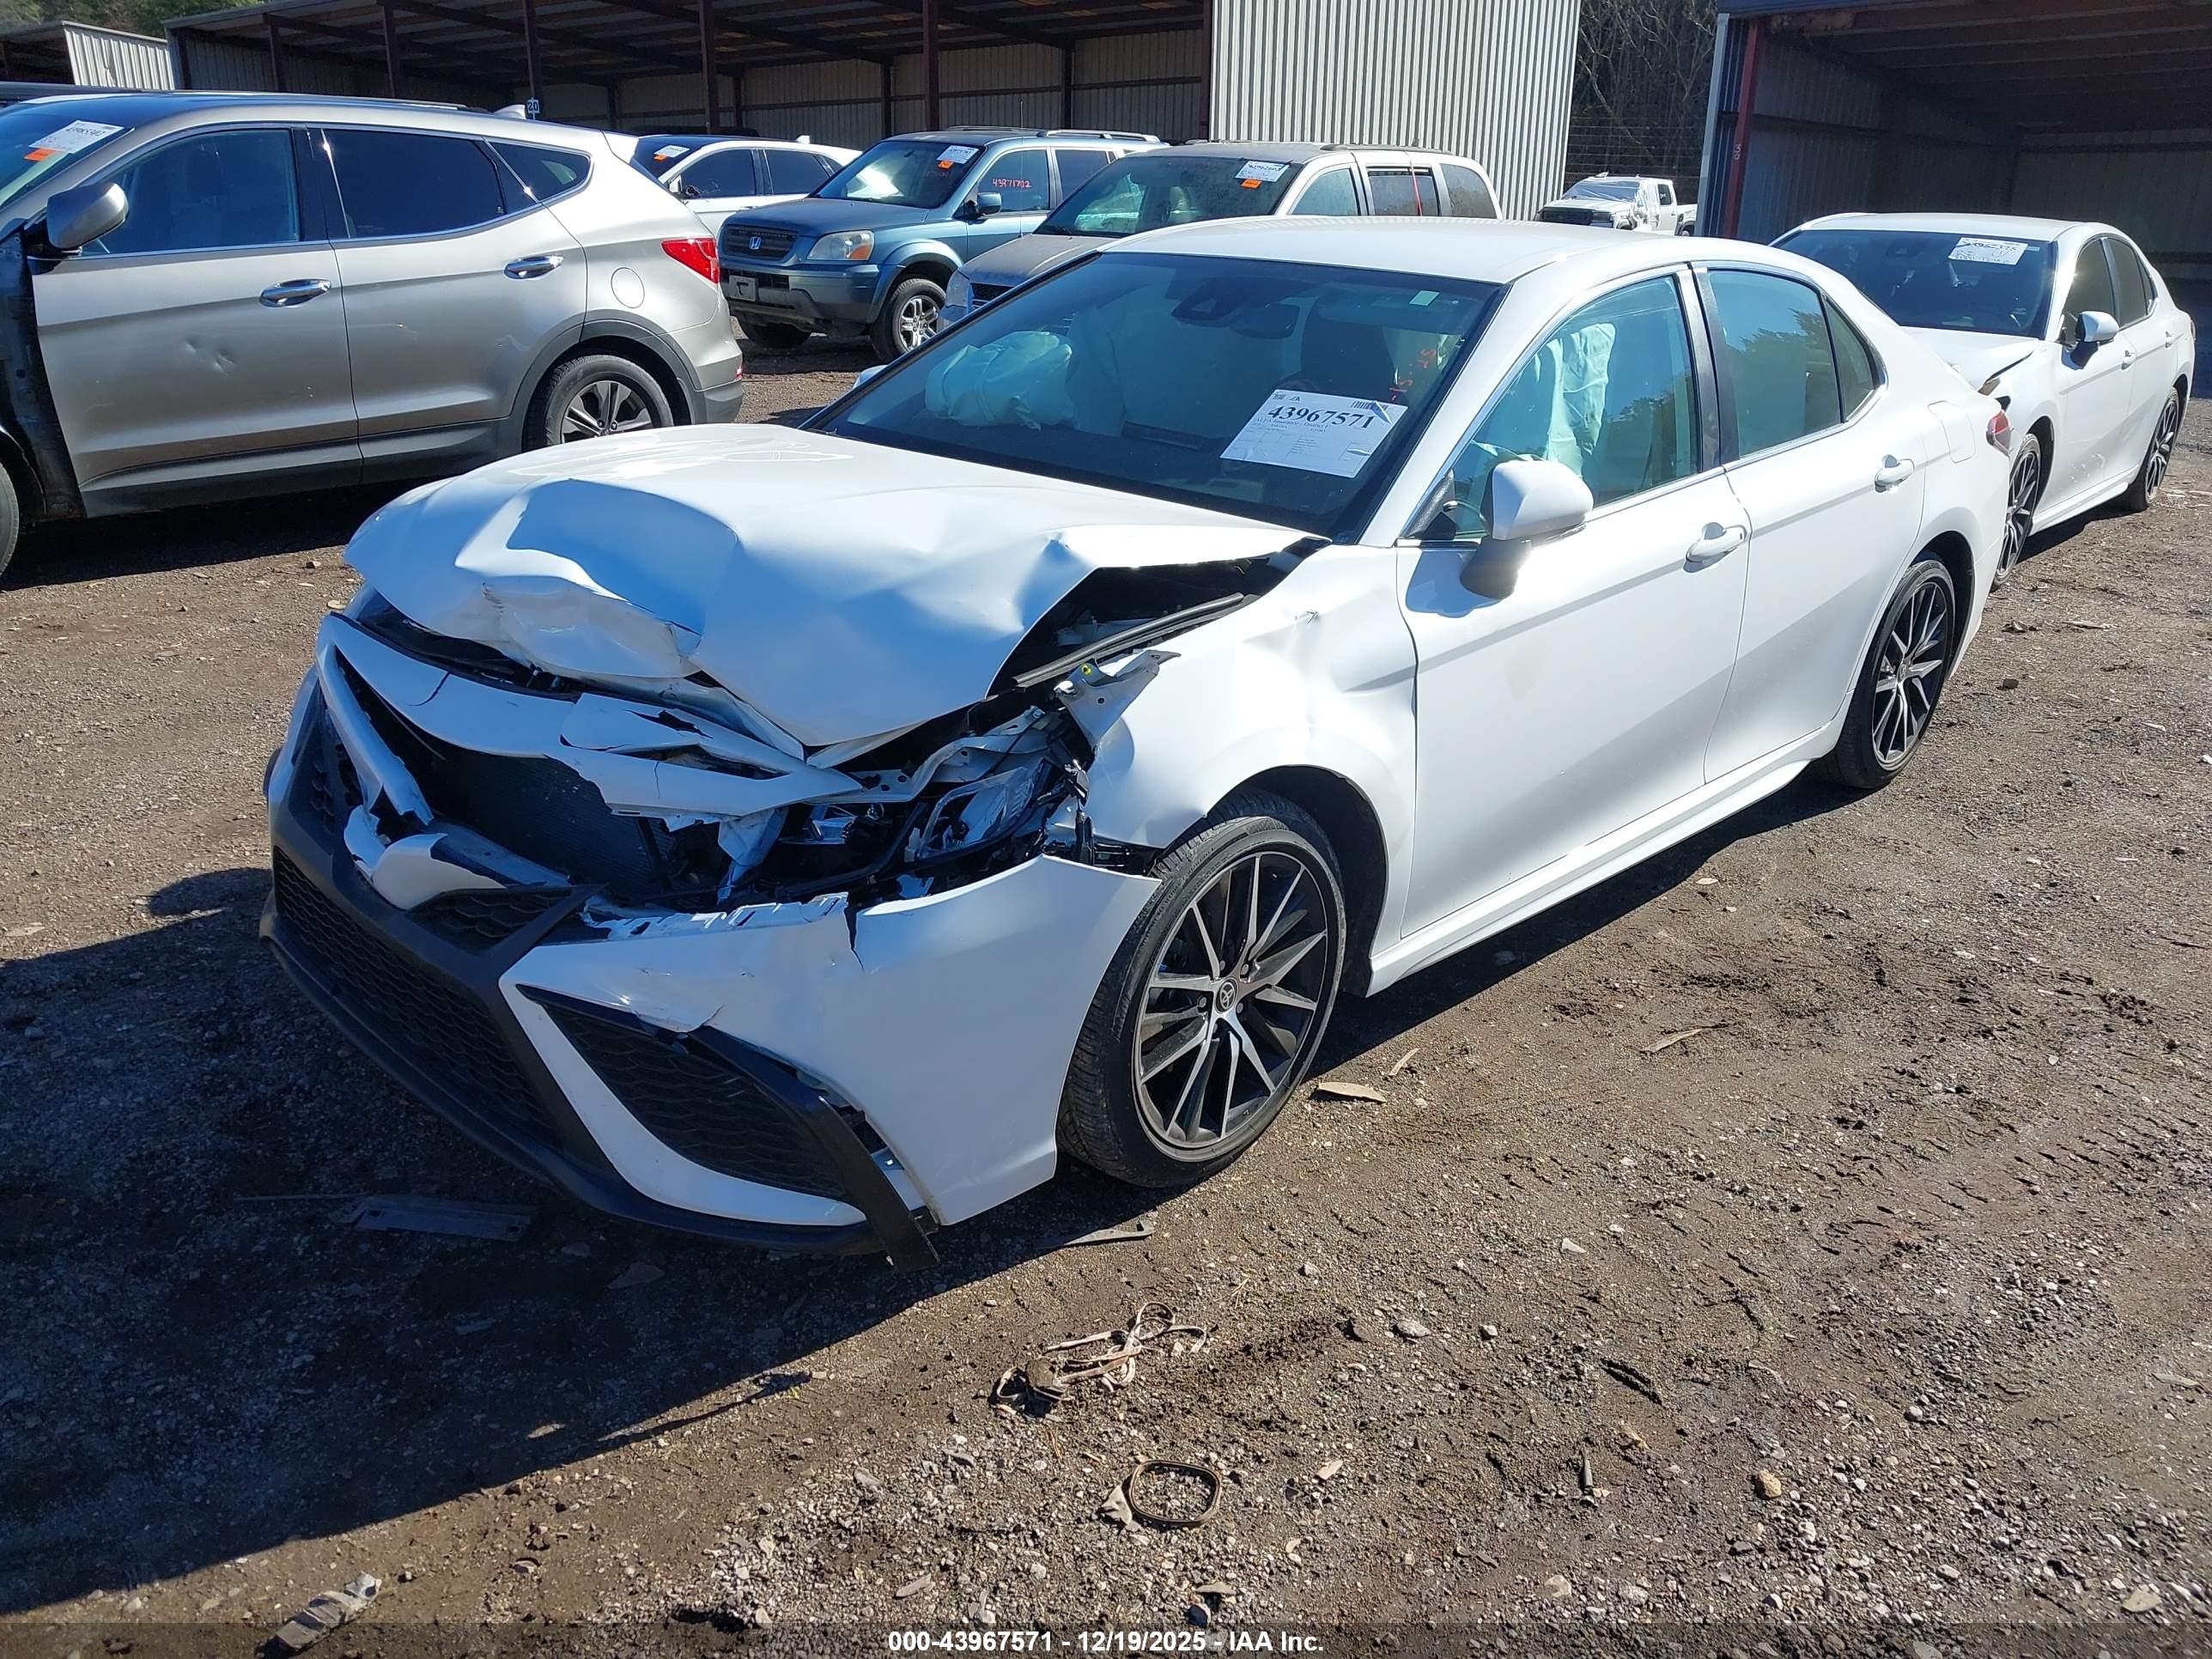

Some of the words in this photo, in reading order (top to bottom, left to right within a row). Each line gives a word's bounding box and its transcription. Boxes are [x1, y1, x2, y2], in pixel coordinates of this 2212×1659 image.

[528, 101, 538, 112] 20
[993, 179, 1031, 188] 43971702
[1267, 405, 1375, 428] 43967571
